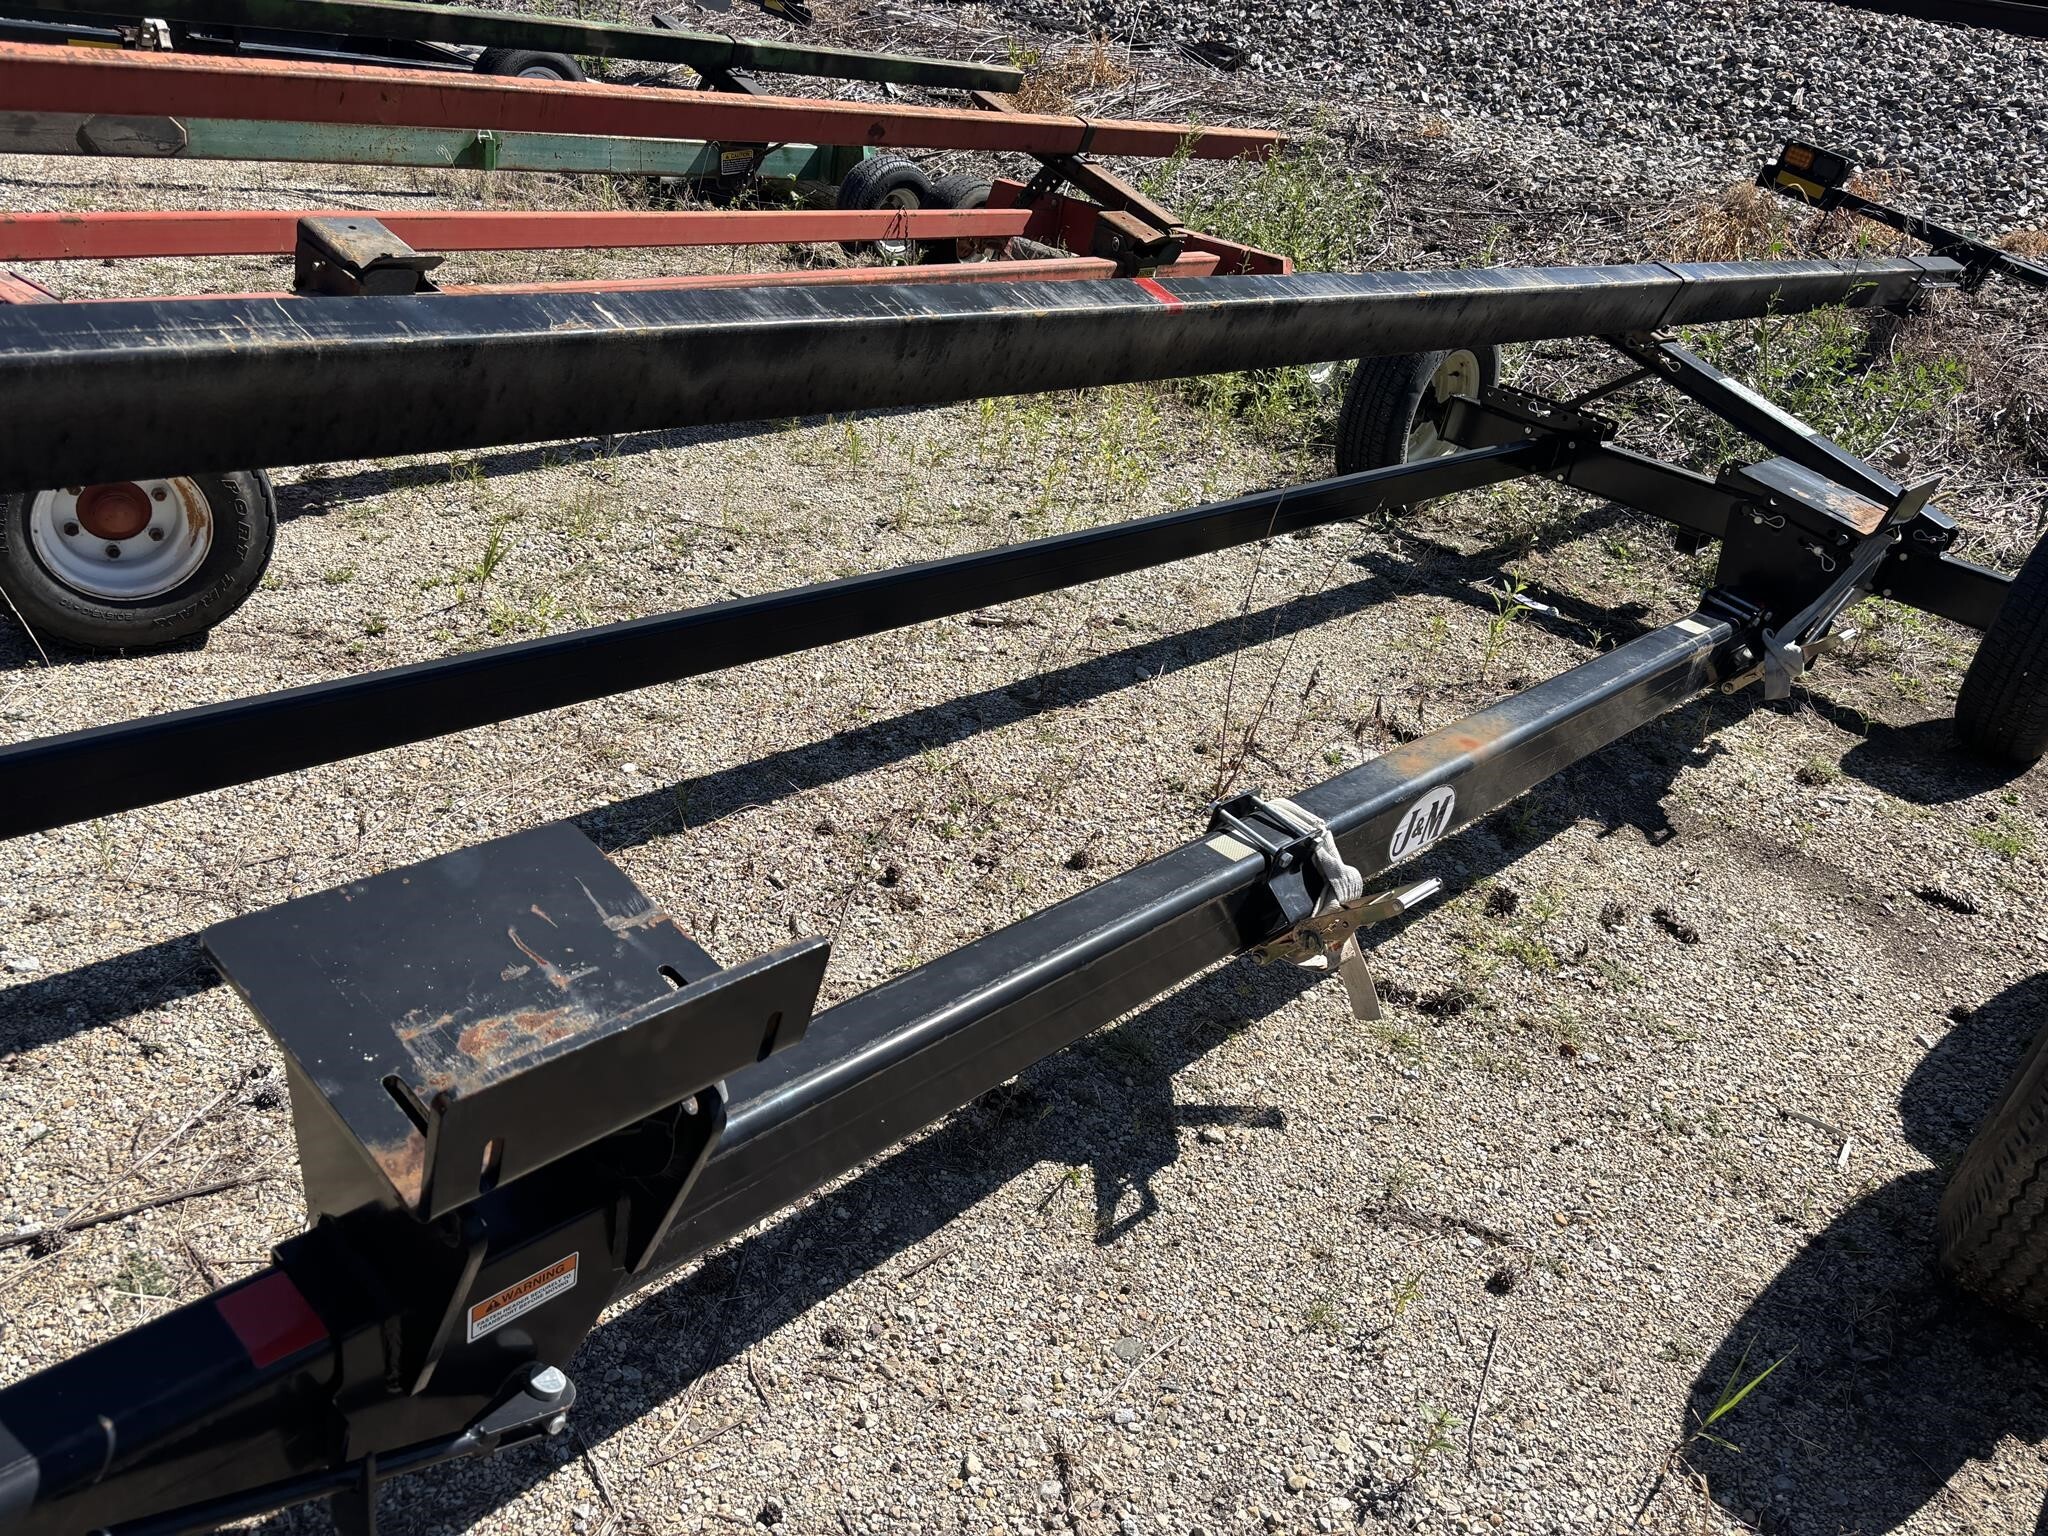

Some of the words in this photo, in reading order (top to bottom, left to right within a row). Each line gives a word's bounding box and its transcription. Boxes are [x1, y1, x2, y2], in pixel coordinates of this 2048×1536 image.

[220, 479, 252, 561] PORT
[1392, 794, 1453, 857] J&M
[476, 1311, 502, 1327] FASTEN
[503, 1296, 529, 1315] HEADER
[530, 1279, 561, 1298] SECURELY
[561, 1274, 571, 1284] TO
[479, 1307, 518, 1331] TRANSPORT
[519, 1293, 544, 1309] BEFORE
[545, 1280, 569, 1296] MOVING
[501, 1264, 565, 1302] WARNING
